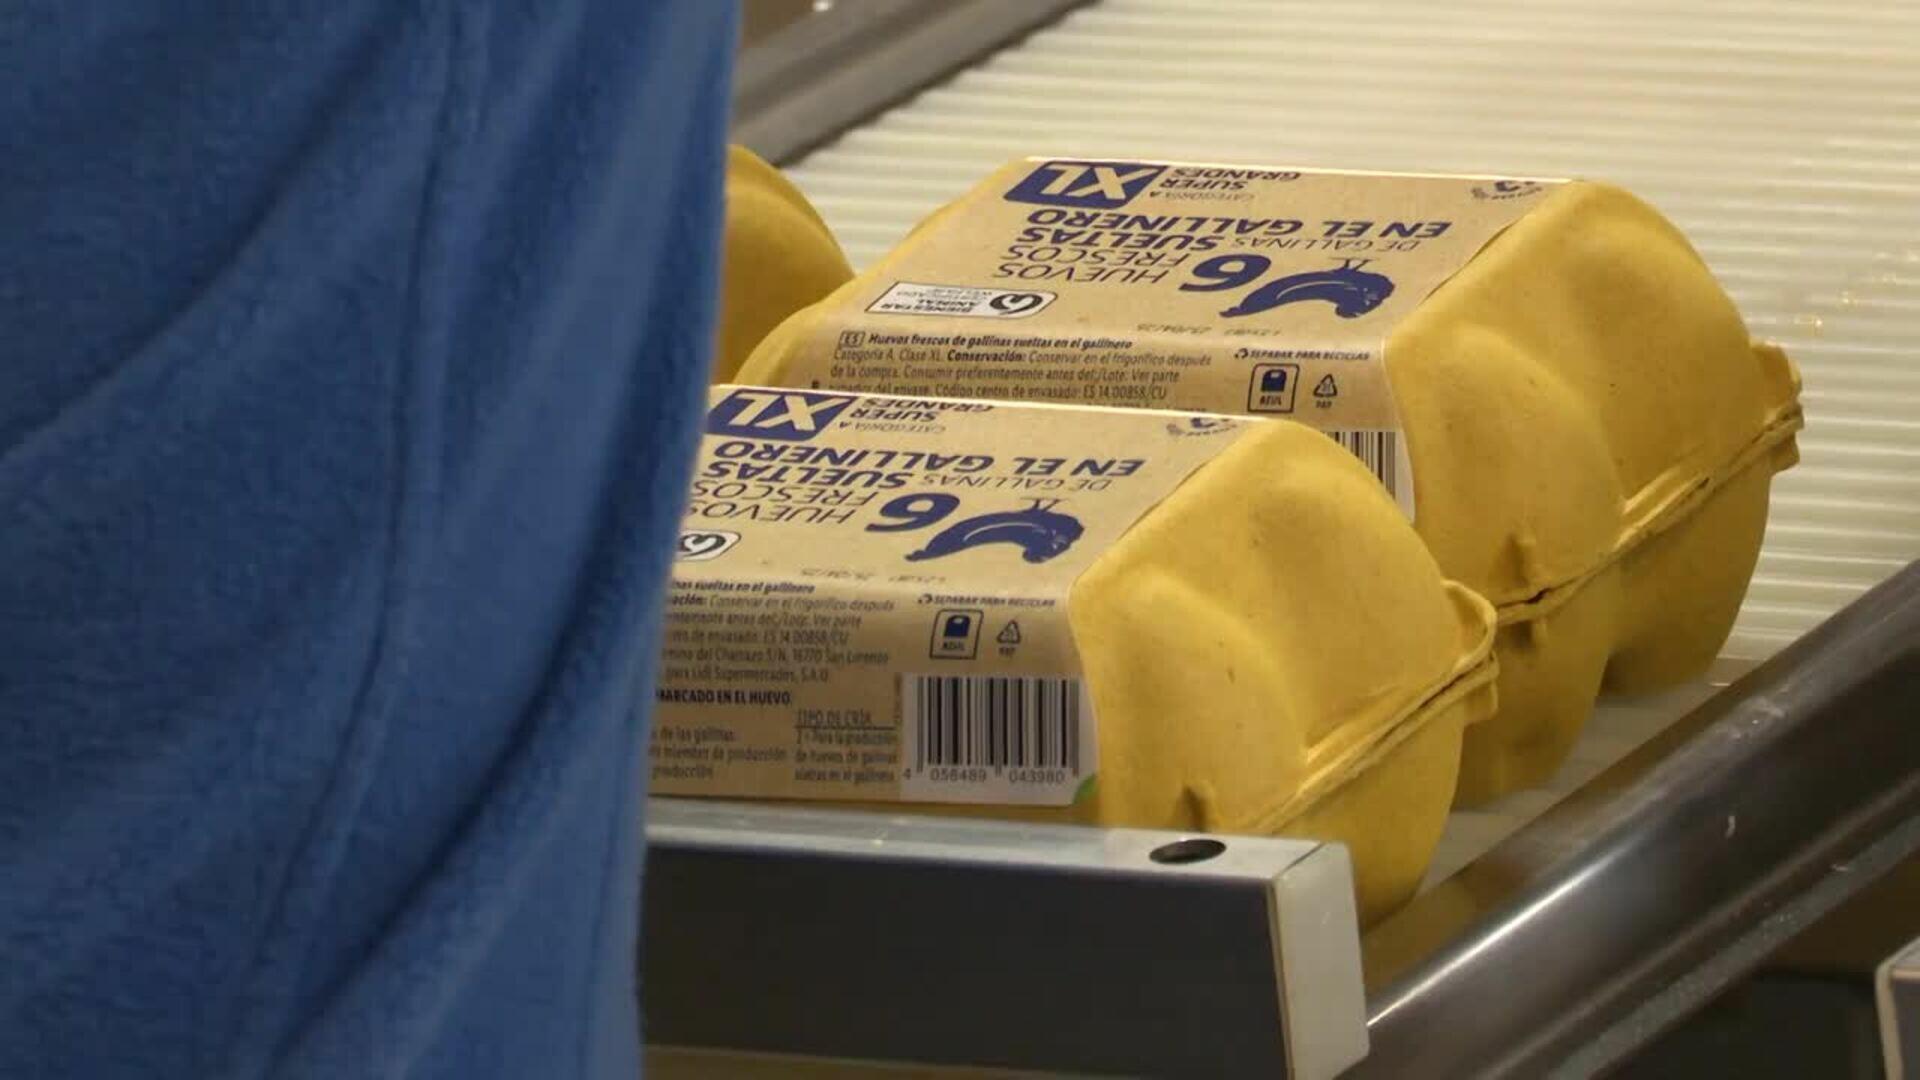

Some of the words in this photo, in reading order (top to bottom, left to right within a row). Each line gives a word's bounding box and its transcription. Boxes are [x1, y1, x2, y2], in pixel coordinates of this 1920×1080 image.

[1040, 164, 1161, 199] XL
[1174, 167, 1300, 180] GRANDES
[1159, 178, 1248, 190] SUPER
[1027, 209, 1304, 236] GALLINERO
[1323, 220, 1374, 237] EL
[1380, 221, 1452, 238] EN
[1016, 227, 1225, 252] SUELTAS
[1233, 237, 1375, 251] GALLINAS
[1376, 240, 1422, 251] DE
[1001, 245, 1191, 267] FRESCOS
[991, 263, 1170, 284] HUEVOS
[1177, 253, 1272, 292] 6
[869, 333, 909, 344] Huevos
[911, 334, 949, 346] frescos
[951, 335, 967, 346] de
[967, 335, 1011, 350] gallinas
[1013, 337, 1052, 348] sueltas
[1054, 339, 1069, 347] en
[1070, 338, 1083, 348] el
[1081, 338, 1133, 351] gallinero
[899, 348, 927, 361] Clase
[947, 349, 1025, 363] Conservación:
[1028, 350, 1081, 364] Conservar
[1083, 353, 1098, 364] en
[1099, 352, 1112, 365] el
[1167, 353, 1213, 368] después
[1295, 350, 1321, 360] PARA
[830, 365, 845, 378] de
[847, 365, 856, 378] la
[904, 364, 952, 379] Consumir
[955, 366, 1044, 383] preferentemente
[1046, 368, 1075, 380] antes
[1131, 369, 1150, 382] Ver
[1152, 371, 1180, 384] parte
[1011, 386, 1025, 399] de
[1083, 385, 1096, 399] ES
[727, 394, 855, 431] XL
[861, 398, 996, 413] GRANDES
[850, 407, 940, 422] SUPER
[714, 441, 995, 473] GALLINERO
[1014, 457, 1066, 474] EL
[702, 461, 914, 488] SUELTAS
[1070, 457, 1146, 476] EN
[924, 474, 1065, 491] GALLINAS
[1067, 479, 1113, 491] DE
[693, 480, 880, 506] FRESCOS
[865, 493, 960, 532] 6
[695, 581, 735, 591] sueltas
[736, 582, 751, 592] en
[751, 582, 764, 593] el
[763, 582, 815, 595] gallinero
[717, 691, 731, 704] EN
[733, 691, 746, 704] EL
[903, 768, 911, 780] 4
[930, 768, 987, 783] 056489
[1009, 768, 1065, 785] 043980
